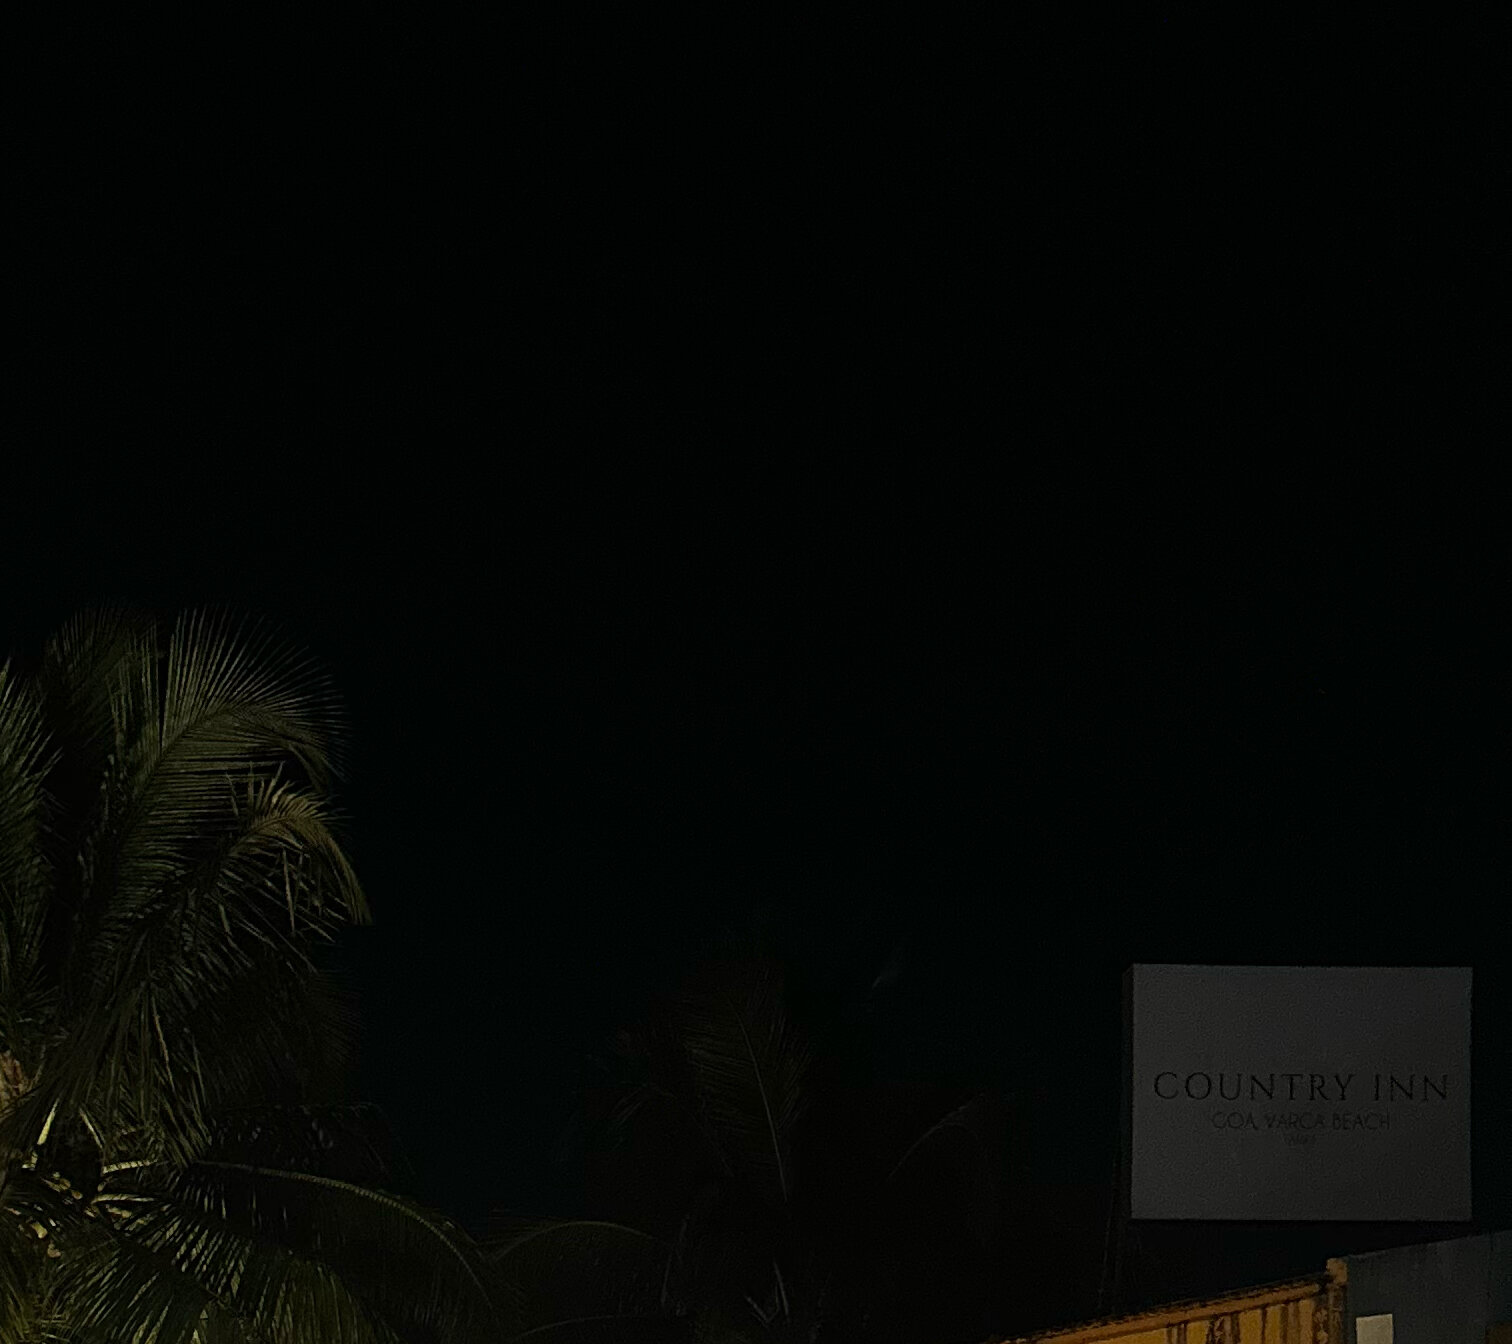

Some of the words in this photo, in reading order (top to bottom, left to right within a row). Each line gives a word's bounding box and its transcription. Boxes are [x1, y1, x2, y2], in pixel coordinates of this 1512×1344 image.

[1153, 1071, 1355, 1101] COUNTRY
[1372, 1072, 1449, 1102] INN
[1211, 1111, 1258, 1131] GOA
[1331, 1111, 1390, 1131] BEACH
